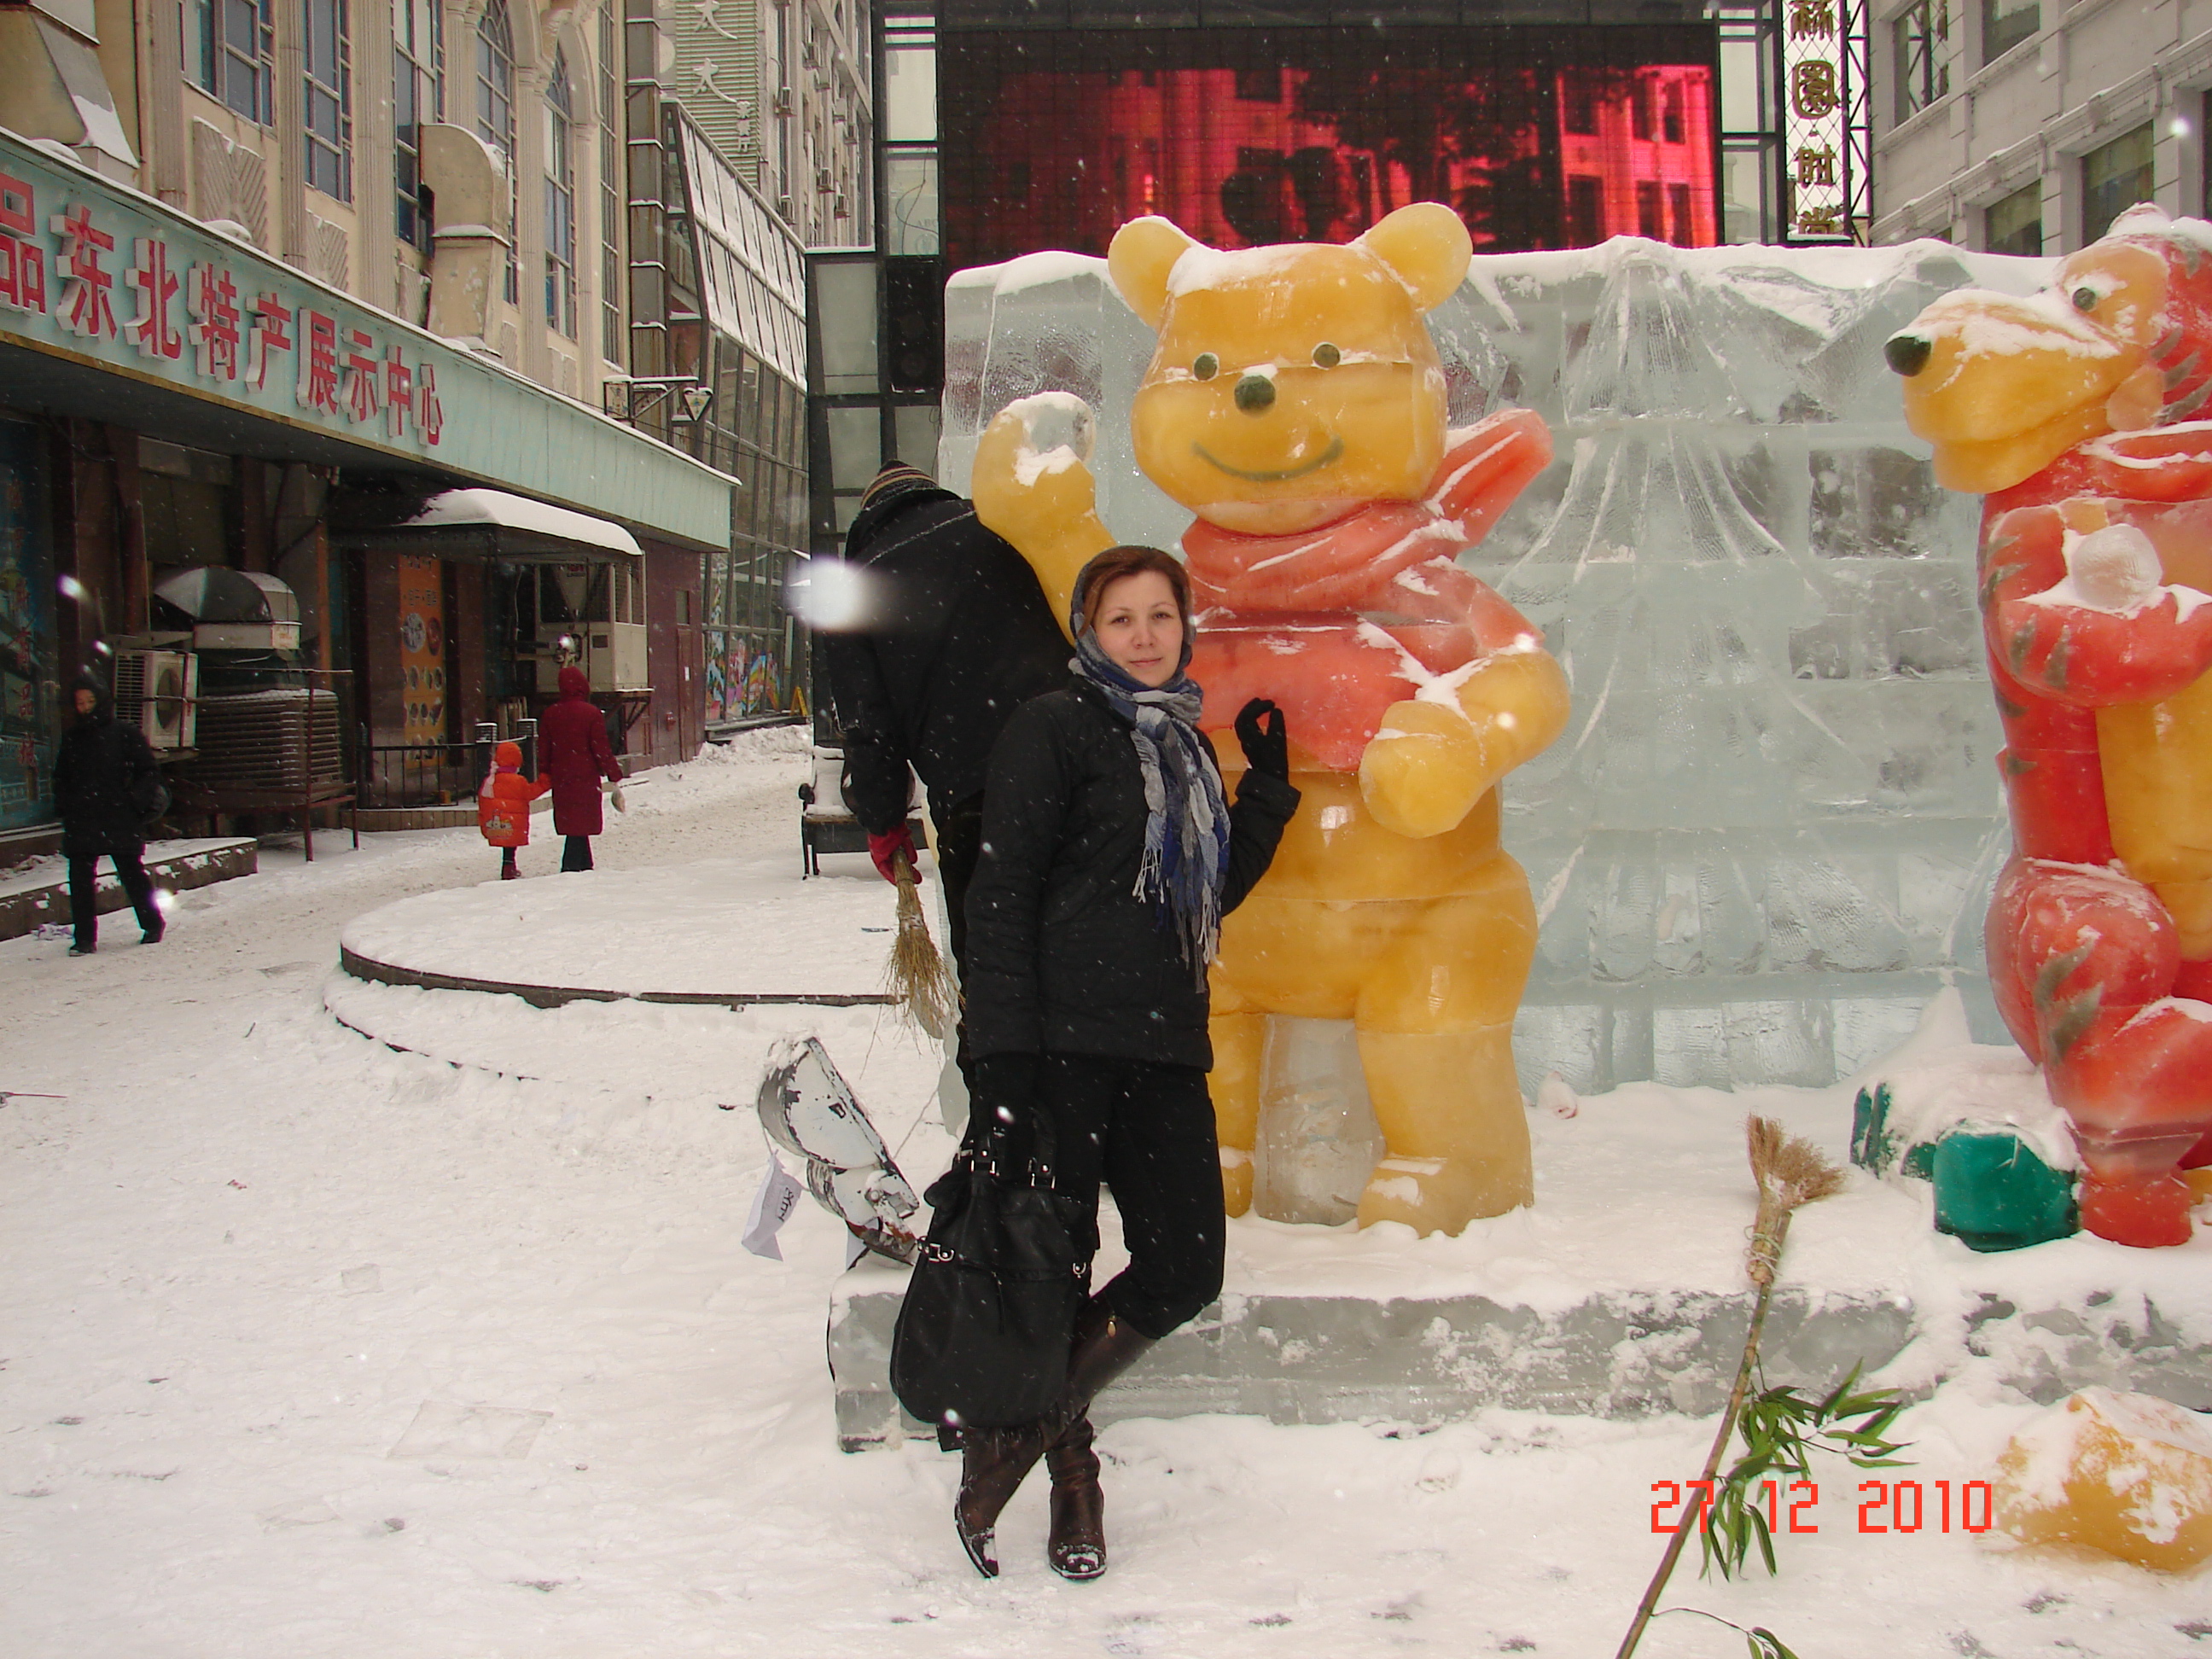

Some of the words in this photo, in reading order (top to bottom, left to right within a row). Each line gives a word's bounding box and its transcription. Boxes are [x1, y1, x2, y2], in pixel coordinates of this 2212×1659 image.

[0, 171, 444, 447] 品东北特产展示中心
